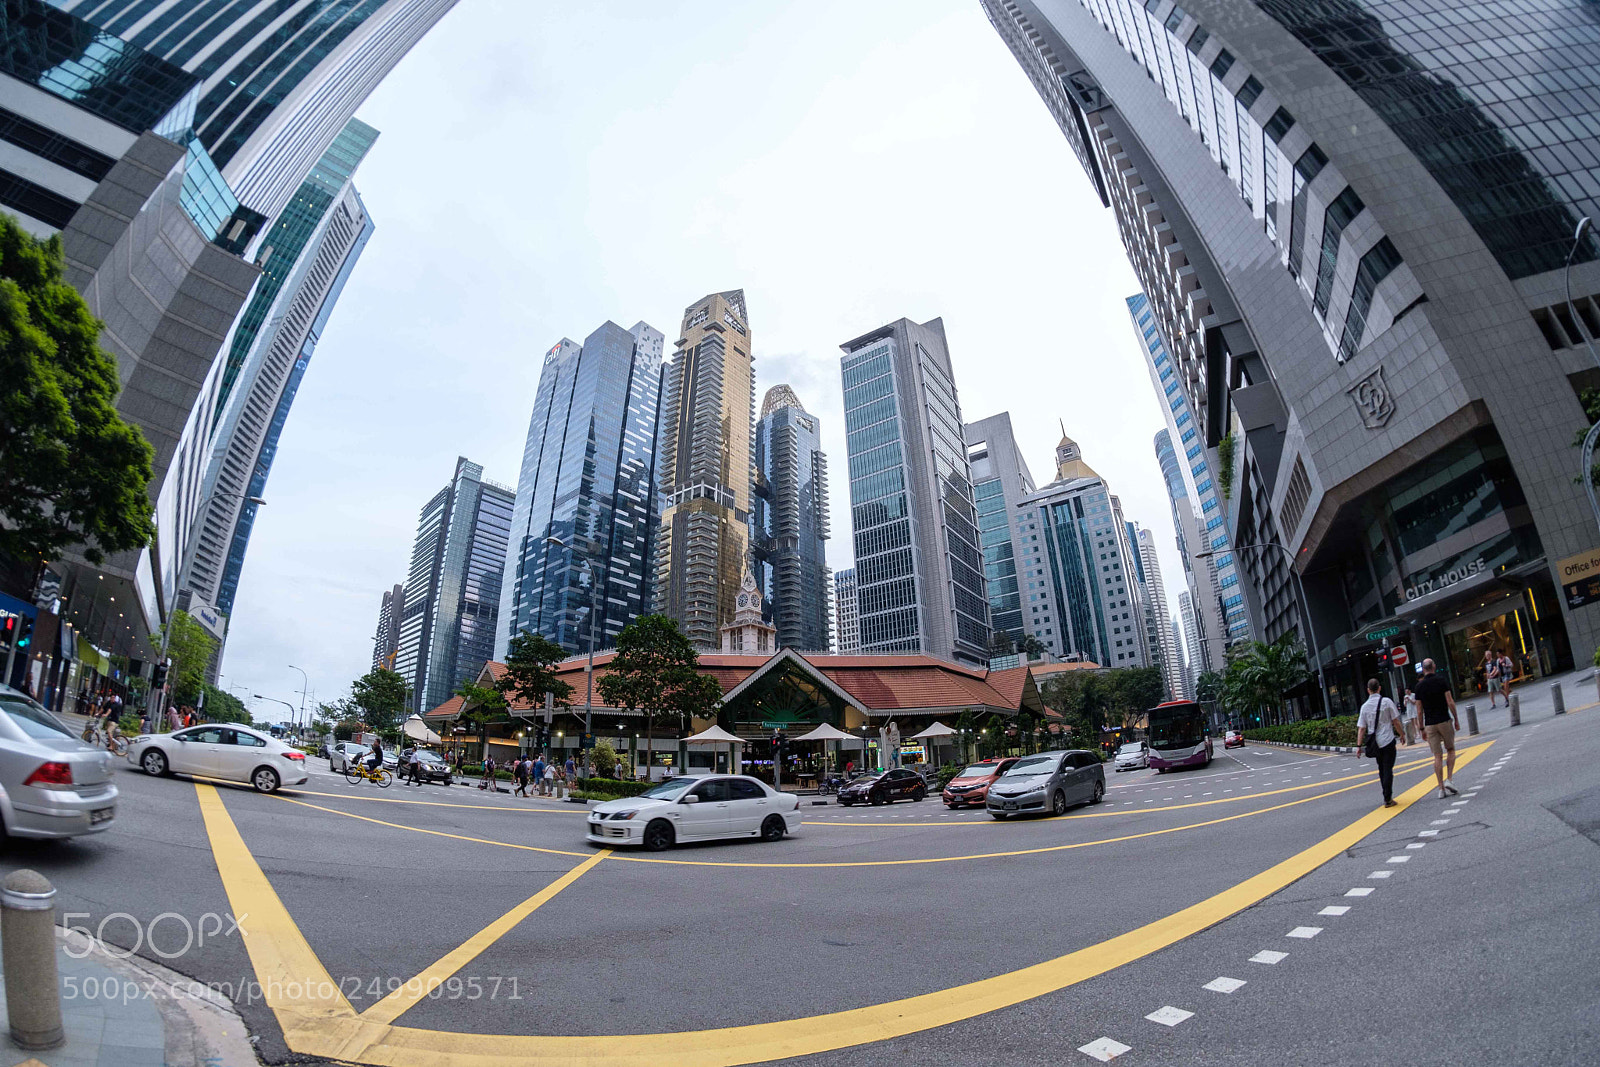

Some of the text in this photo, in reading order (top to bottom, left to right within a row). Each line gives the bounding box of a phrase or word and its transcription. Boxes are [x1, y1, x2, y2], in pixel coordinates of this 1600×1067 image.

[546, 345, 561, 364] citi
[1564, 558, 1600, 576] Office fo
[1405, 558, 1486, 600] CITY HOUSE
[1369, 631, 1388, 640] Cross
